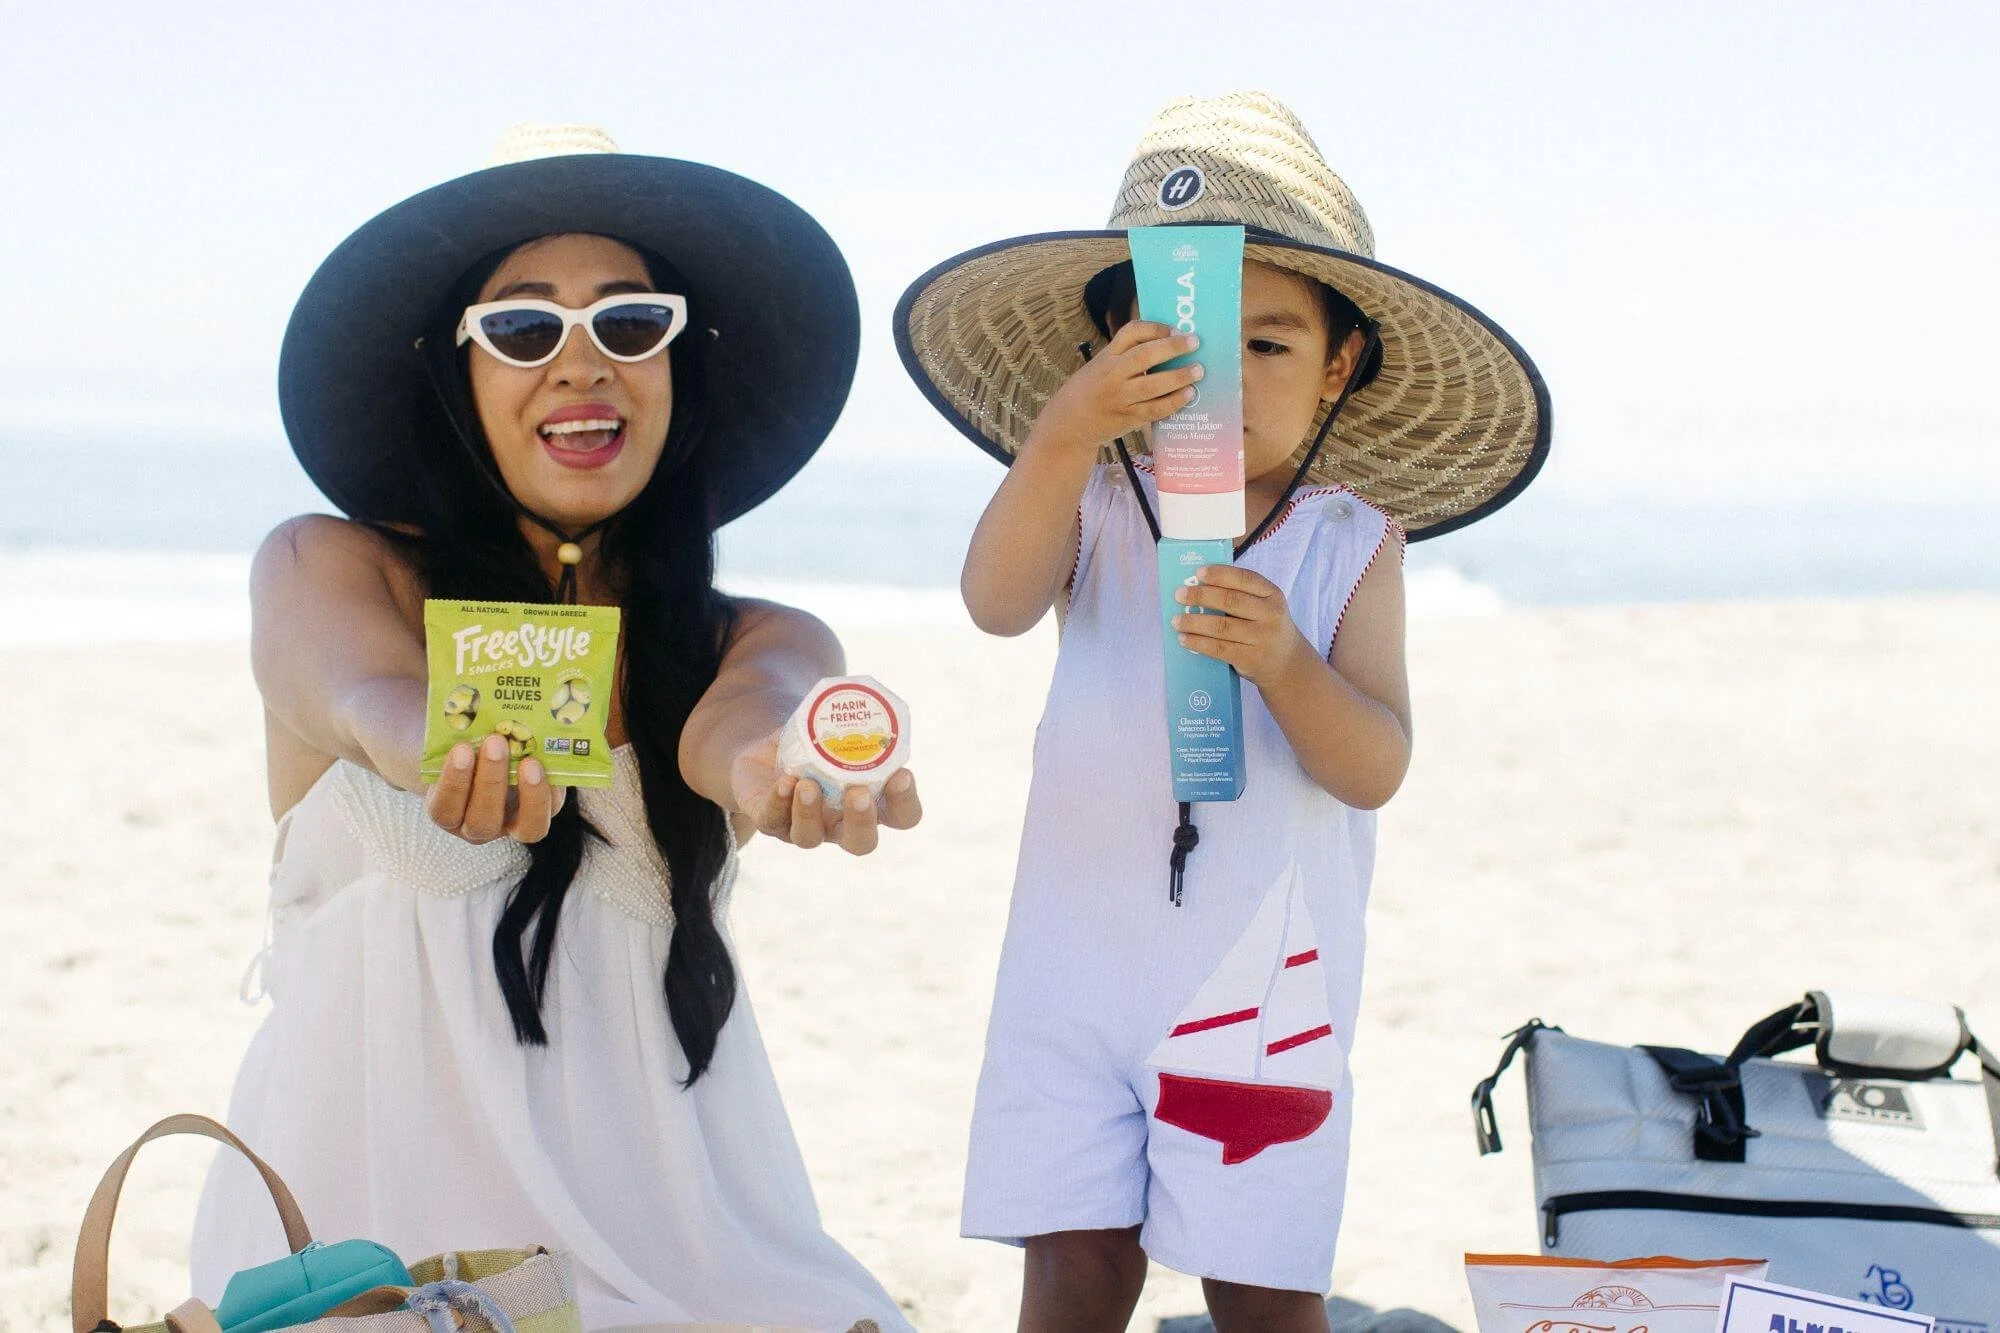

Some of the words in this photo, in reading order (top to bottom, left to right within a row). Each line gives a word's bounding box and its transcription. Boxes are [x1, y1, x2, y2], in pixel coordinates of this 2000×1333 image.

[1168, 176, 1194, 199] H
[1176, 266, 1195, 335] OOLA
[1158, 421, 1195, 430] Sunscreen
[1197, 421, 1223, 430] Lotion
[523, 608, 550, 616] GROWN
[468, 659, 514, 676] SNACKS
[496, 675, 541, 687] GREEN
[494, 688, 542, 701] OLIVES
[831, 700, 867, 711] MARIN
[1193, 696, 1207, 706] 50
[501, 703, 534, 711] ORIGINAL
[830, 710, 871, 723] FRENCH
[575, 741, 588, 749] 40
